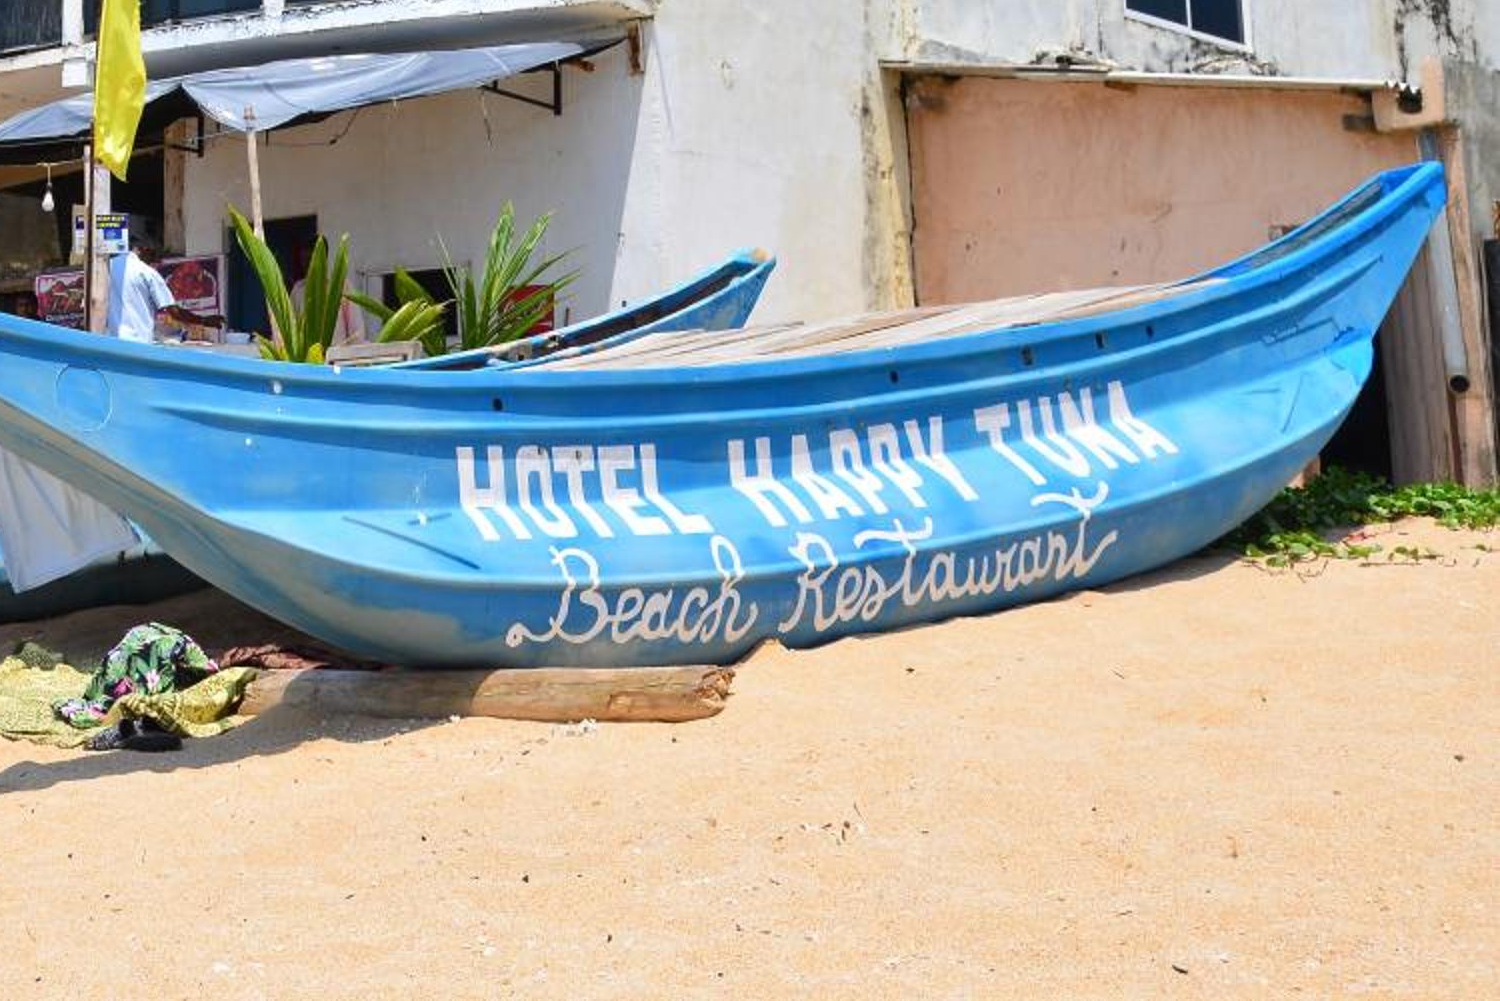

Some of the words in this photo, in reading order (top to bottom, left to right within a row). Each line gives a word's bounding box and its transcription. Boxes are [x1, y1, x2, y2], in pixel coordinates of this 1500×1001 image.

[456, 443, 715, 541] HOTEL
[727, 416, 979, 527] HAPPY
[973, 381, 1179, 485] TUNA
[505, 535, 758, 647] Beach
[778, 480, 1118, 632] Restaurant
